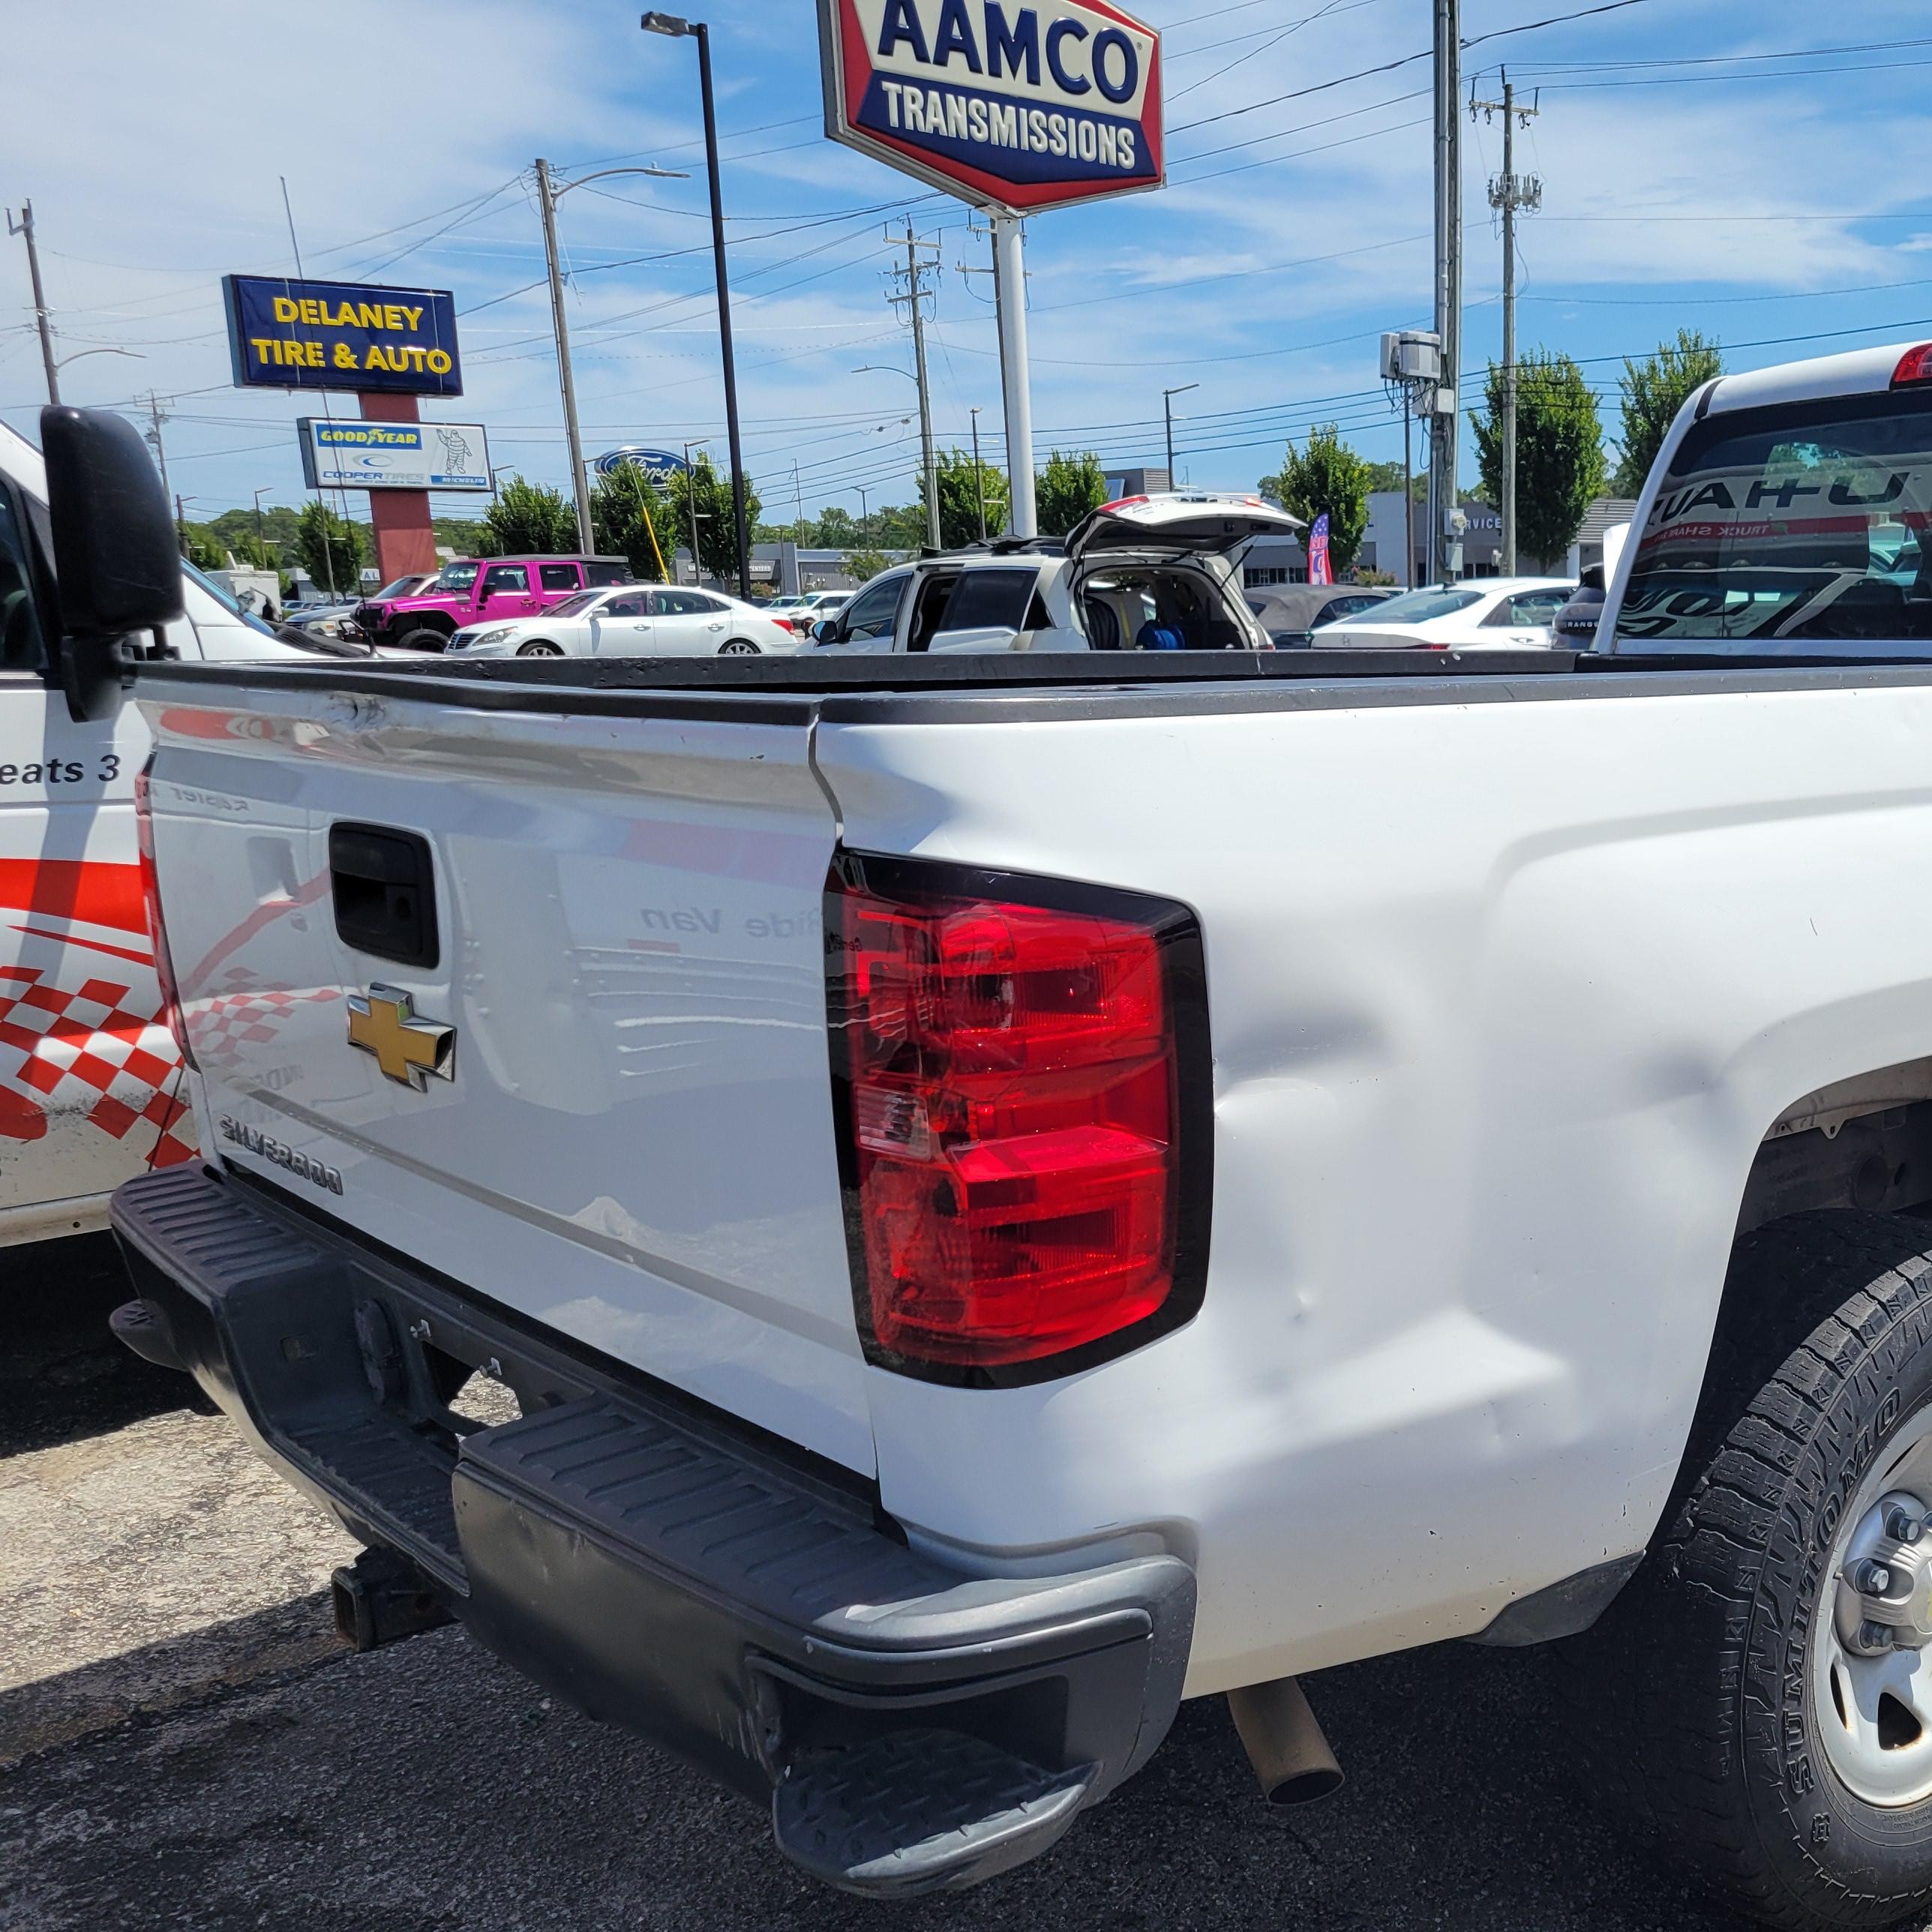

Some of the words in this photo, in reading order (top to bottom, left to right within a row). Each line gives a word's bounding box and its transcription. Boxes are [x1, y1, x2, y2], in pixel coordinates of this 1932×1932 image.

[878, 0, 1138, 104] AAMCO
[880, 80, 1136, 170] TRANSMISSIONS
[273, 297, 424, 331] DELANEY
[250, 338, 326, 368] TIRE
[333, 342, 359, 370] &
[365, 345, 452, 374] AUTO
[1465, 518, 1502, 530] RVICE
[0, 757, 84, 784] eats
[98, 754, 121, 782] 3
[220, 1114, 344, 1196] SILVERADO
[1783, 1387, 1900, 1794] SUMITOMO
